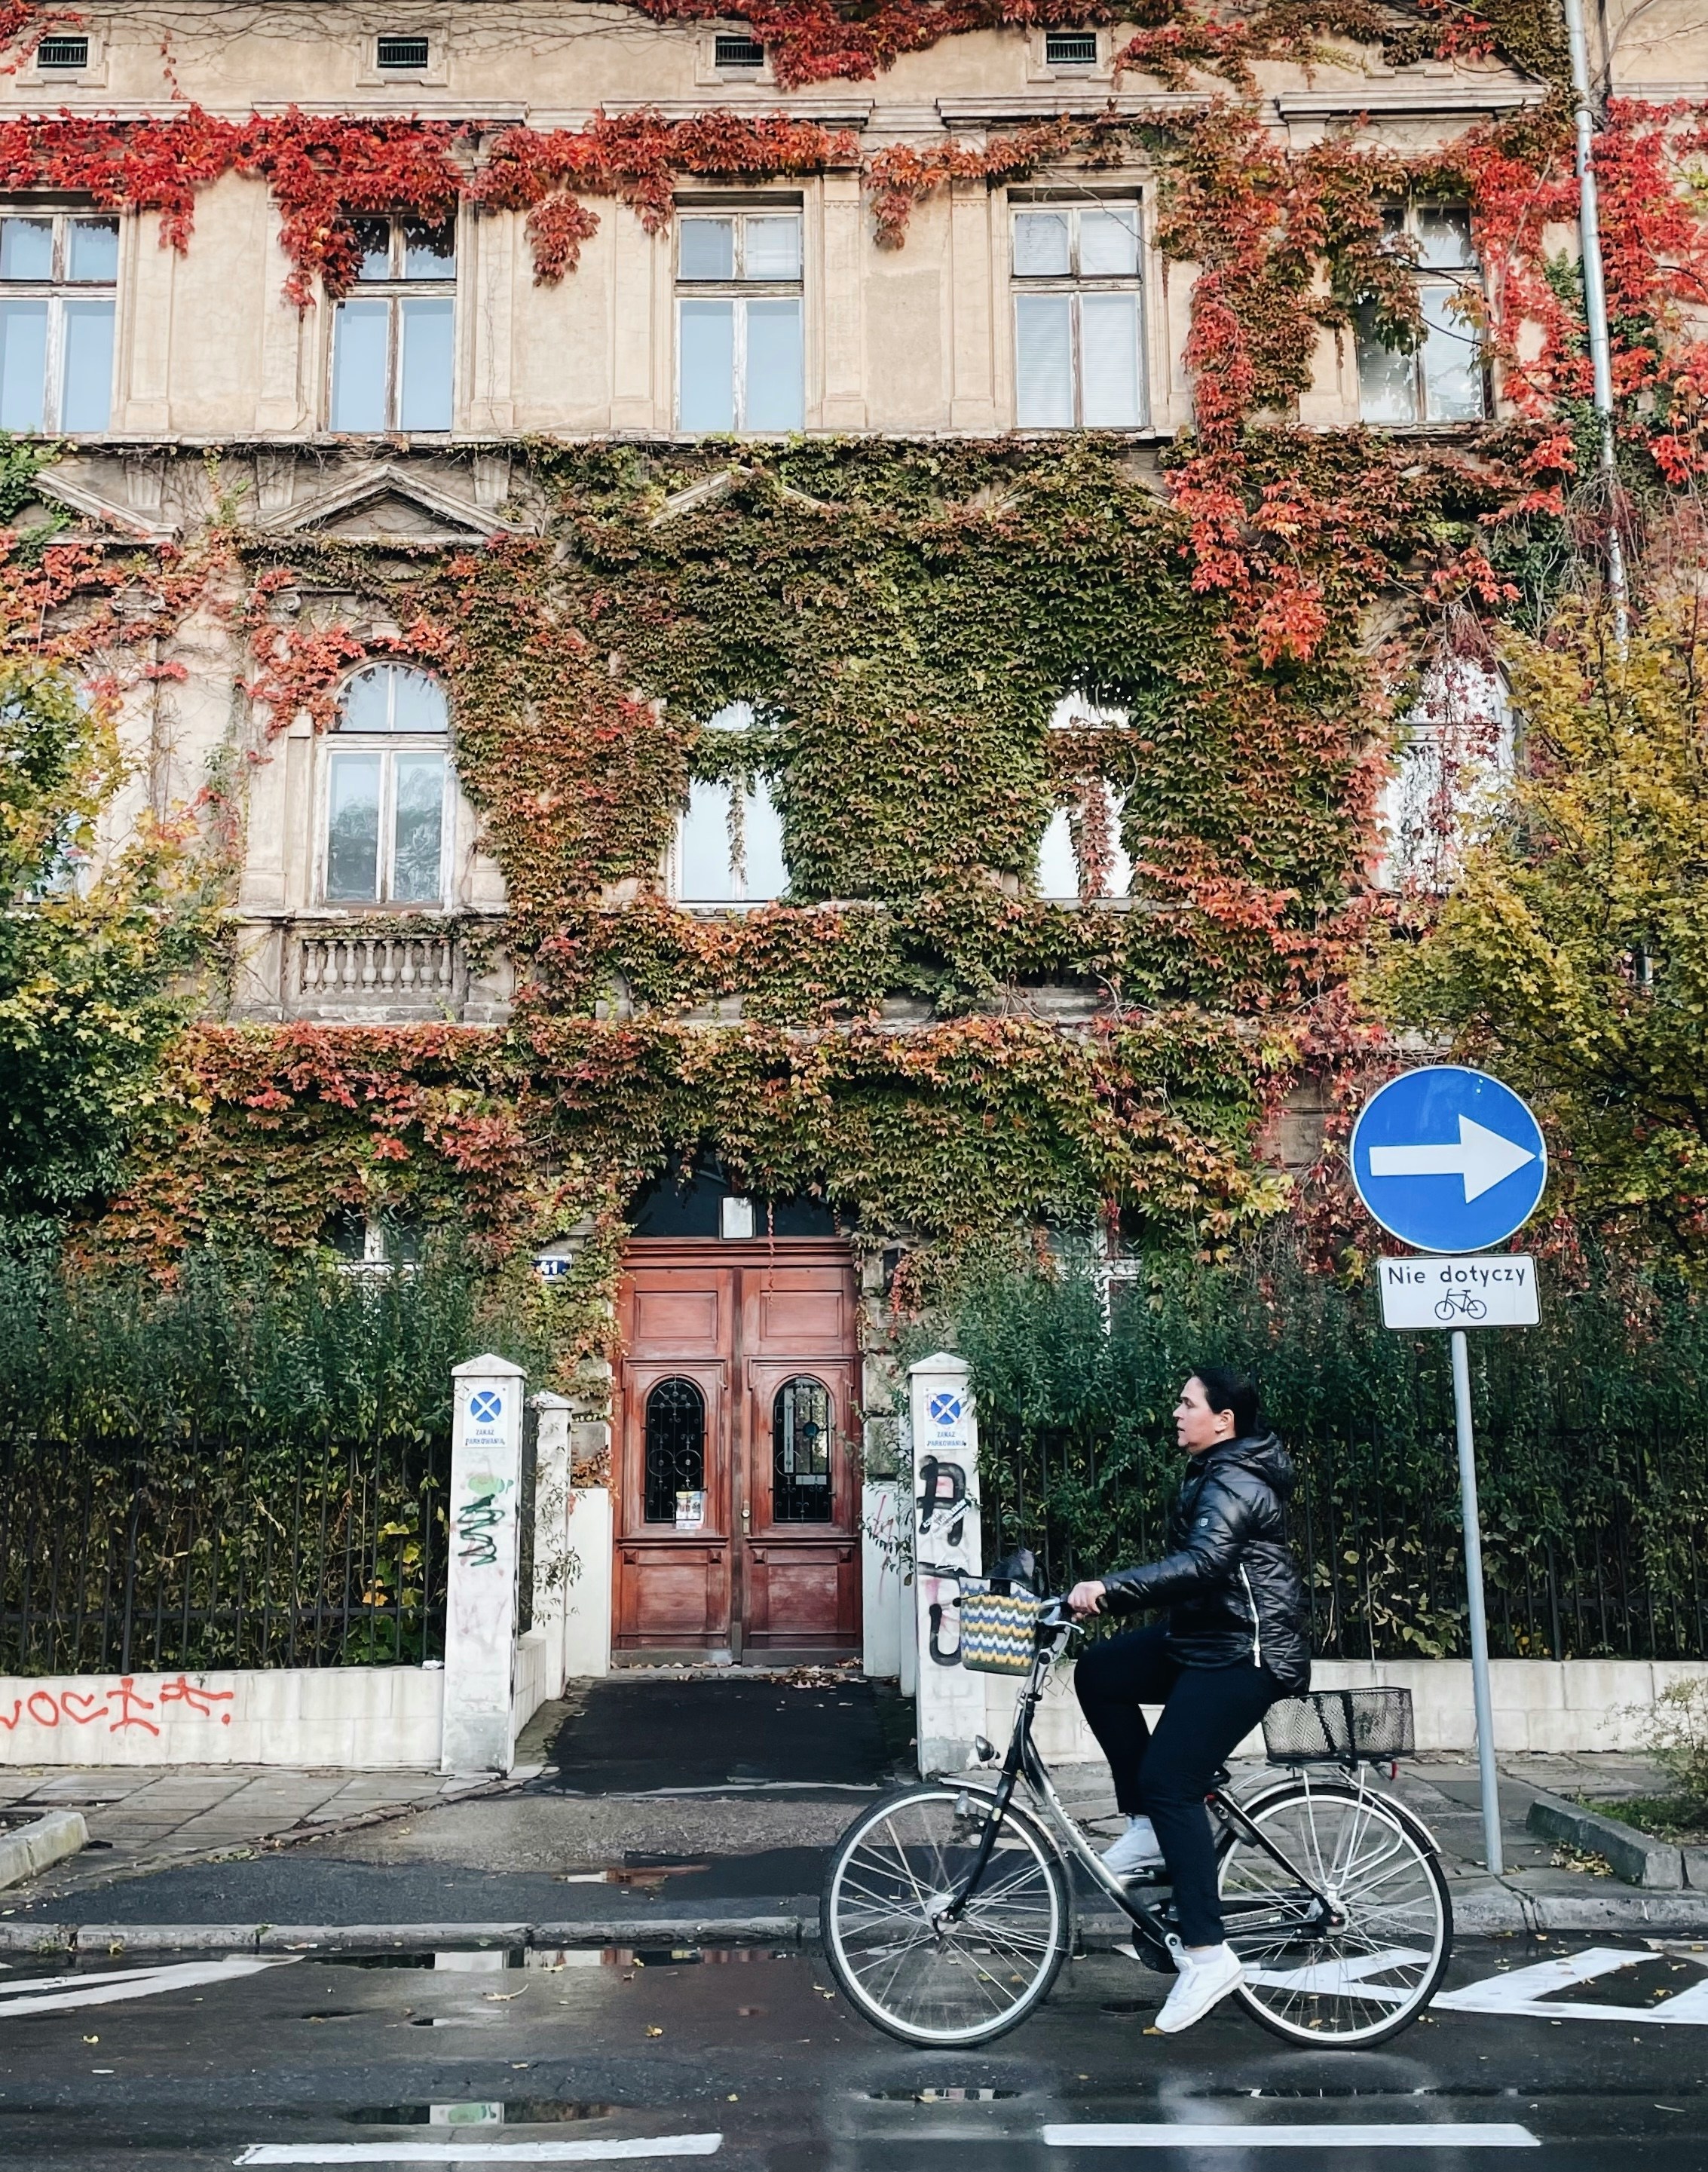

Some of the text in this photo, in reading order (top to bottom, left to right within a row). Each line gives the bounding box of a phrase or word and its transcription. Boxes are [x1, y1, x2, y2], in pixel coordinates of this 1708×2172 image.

[540, 1261, 558, 1275] 41
[1388, 1265, 1525, 1287] Nie dotyczy
